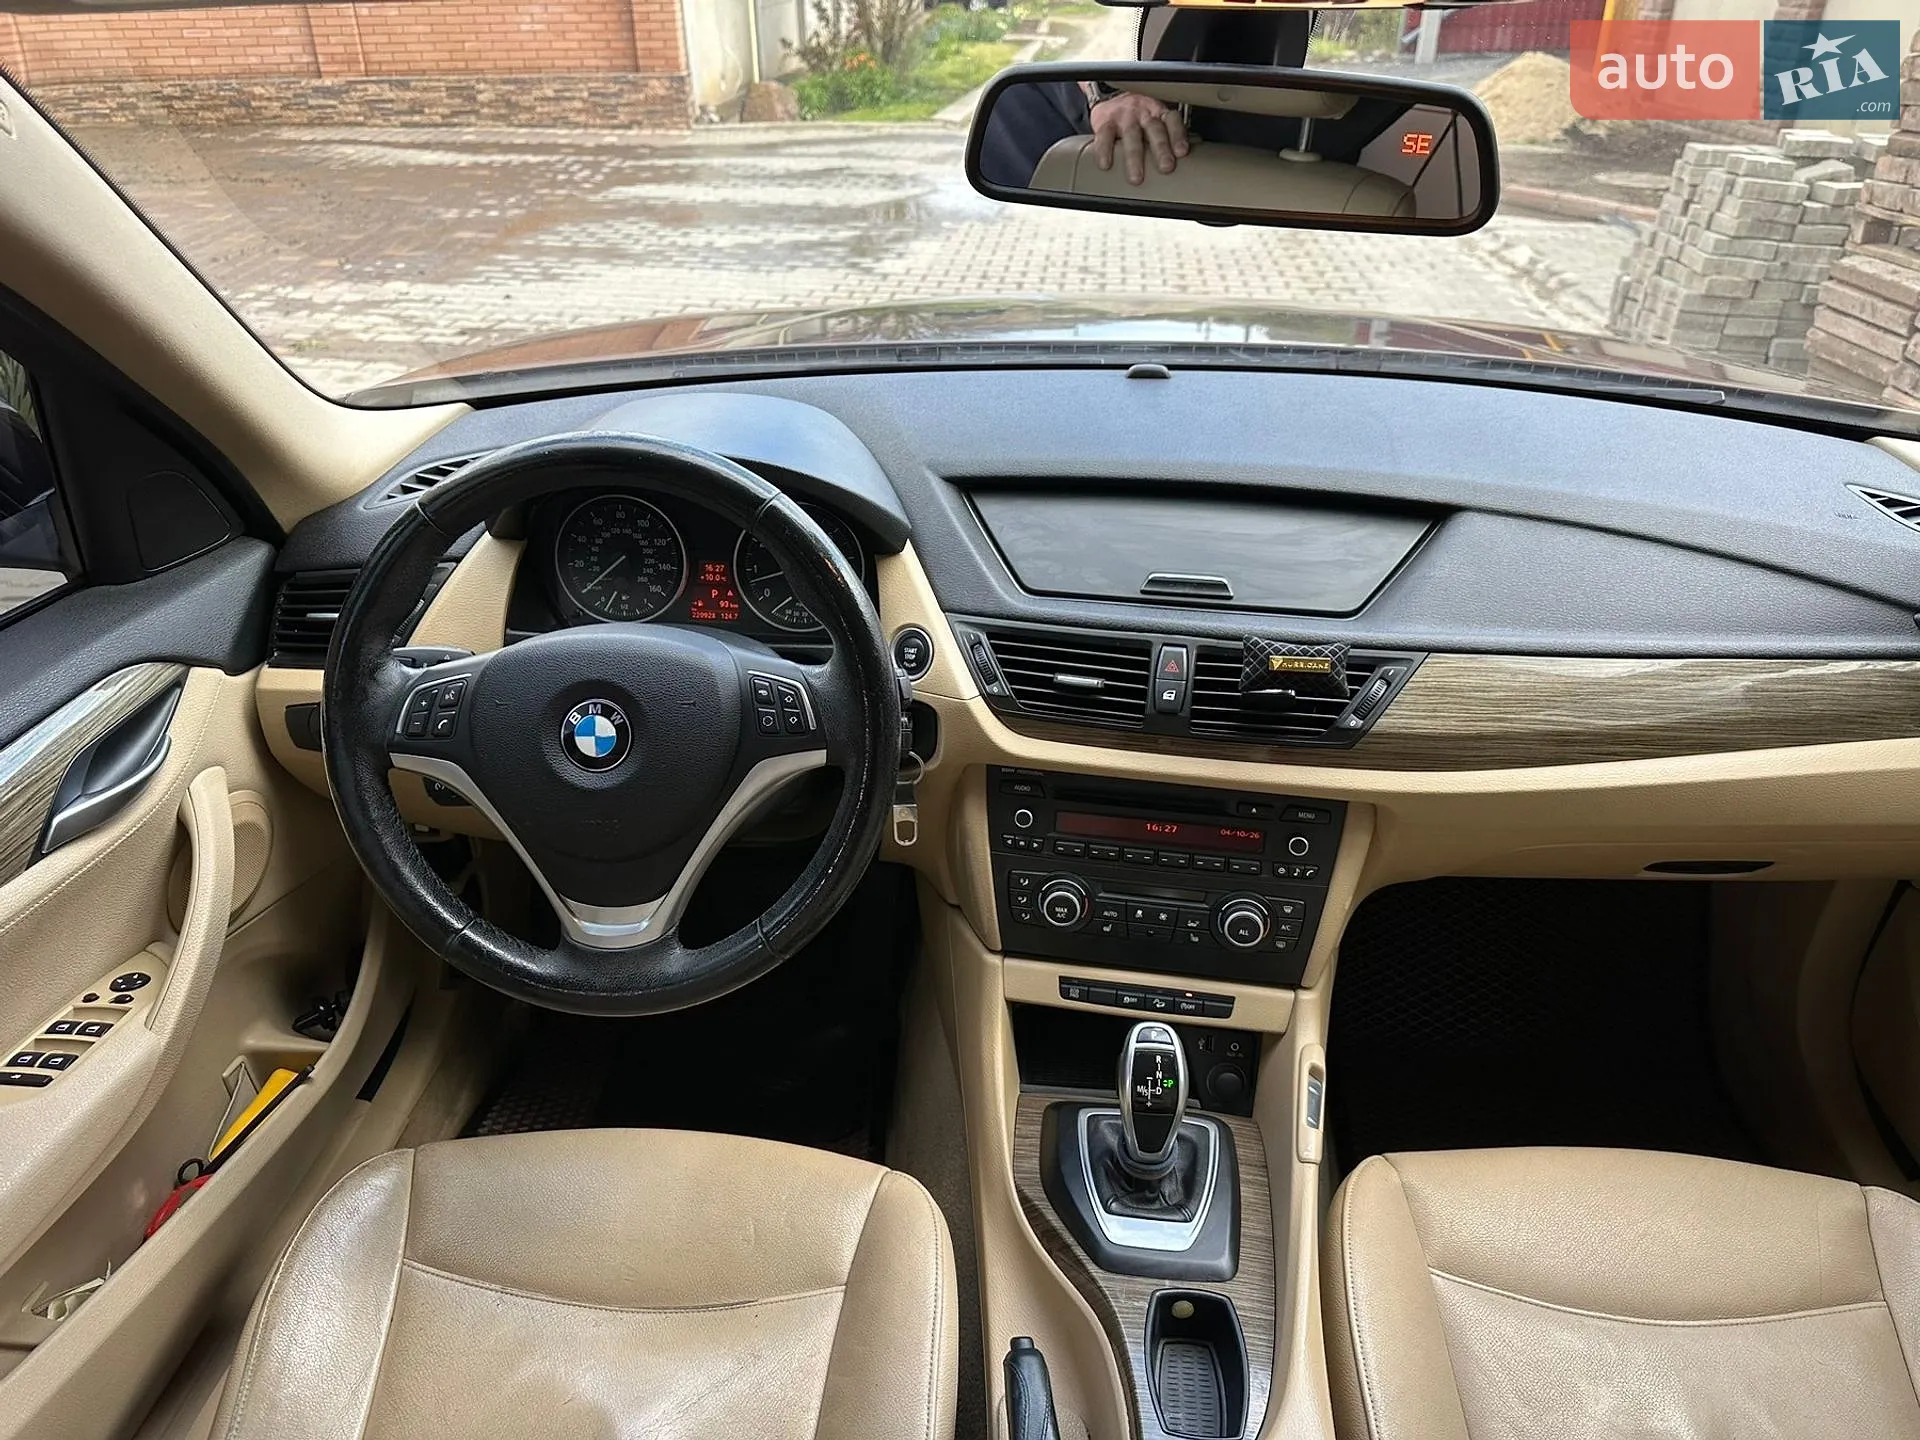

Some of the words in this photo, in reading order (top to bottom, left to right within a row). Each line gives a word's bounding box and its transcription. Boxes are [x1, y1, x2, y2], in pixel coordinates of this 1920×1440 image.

[1401, 133, 1433, 154] SE
[637, 519, 650, 527] 100
[649, 585, 661, 593] 160
[763, 588, 771, 598] 0
[711, 589, 719, 599] P
[568, 703, 624, 726] BMW
[1145, 822, 1178, 834] 16:27
[1219, 828, 1261, 840] 04/10/26
[1102, 910, 1118, 918] AUTO
[1151, 1030, 1158, 1039] P
[1155, 1055, 1162, 1063] R
[1156, 1071, 1162, 1079] N
[1167, 1079, 1174, 1088] P
[1156, 1087, 1163, 1095] D
